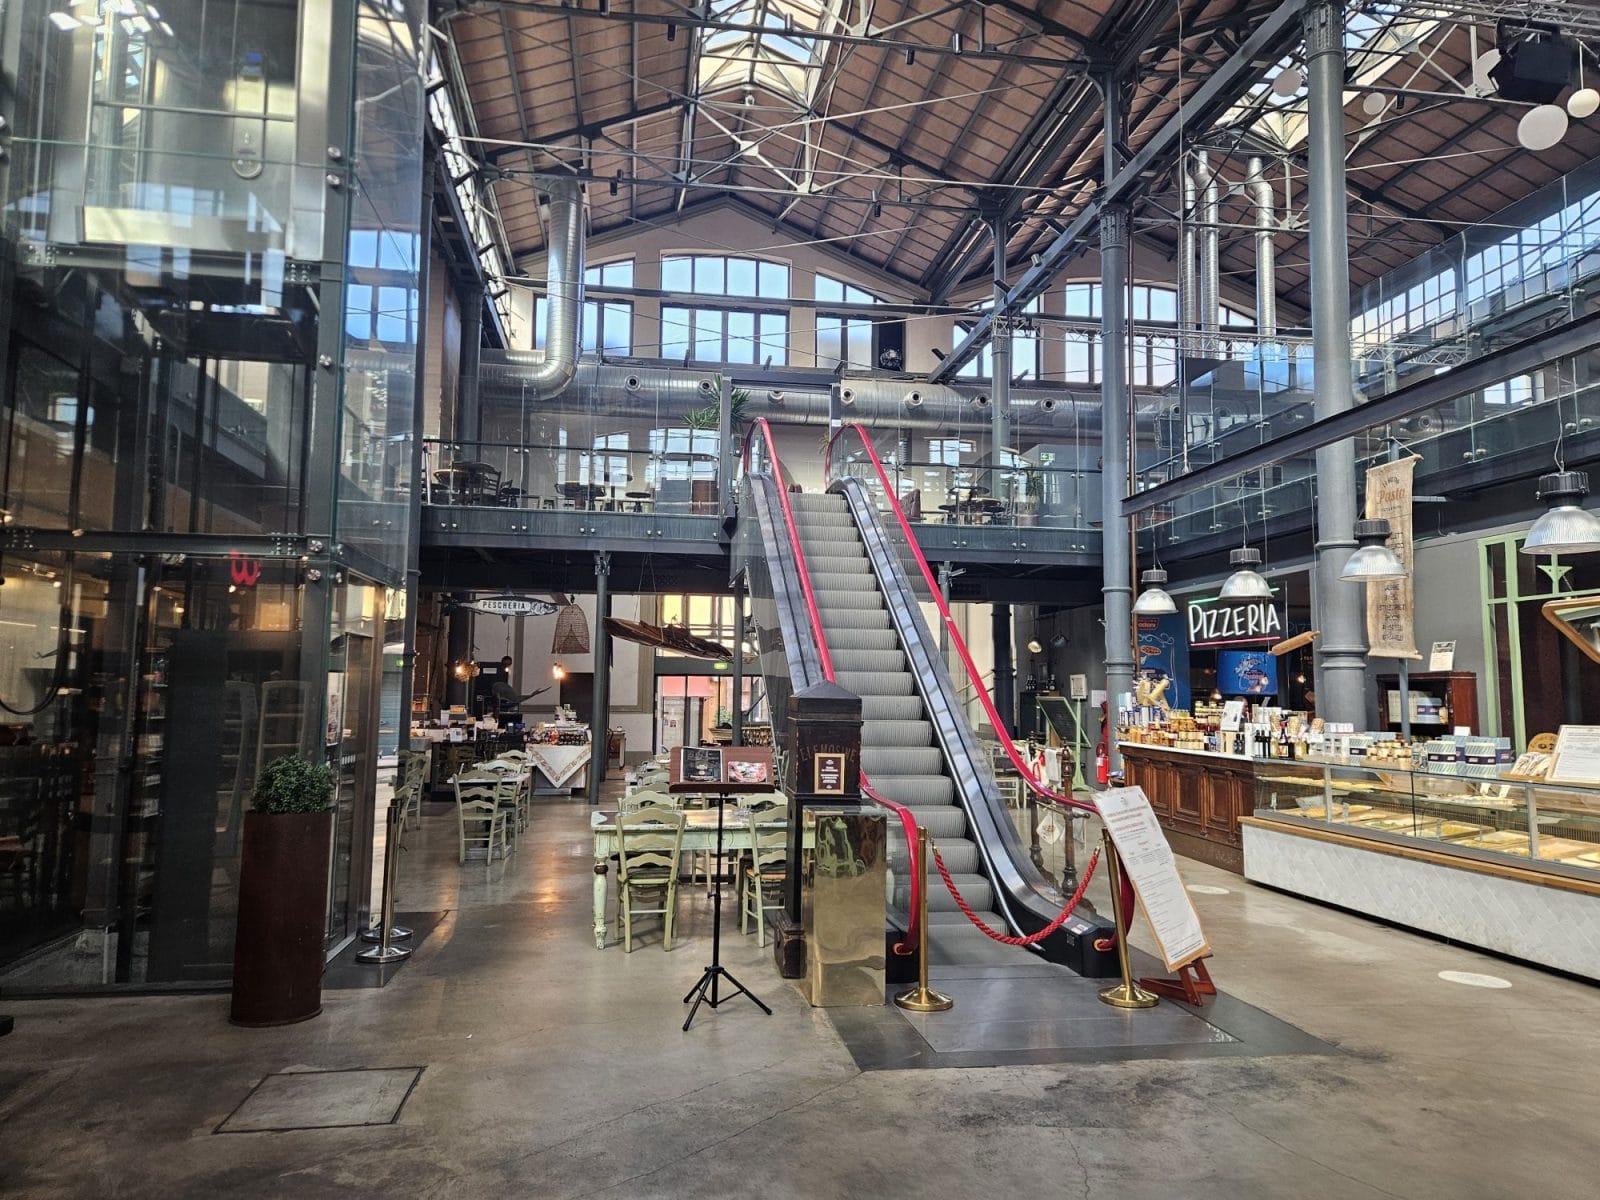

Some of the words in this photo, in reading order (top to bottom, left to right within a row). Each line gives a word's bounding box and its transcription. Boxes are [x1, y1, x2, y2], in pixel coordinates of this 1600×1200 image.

[1376, 487, 1406, 504] Pasta
[482, 601, 525, 610] PESCHERIA
[1188, 603, 1281, 643] PIZZERIA
[800, 744, 857, 762] ELEMOSINE
